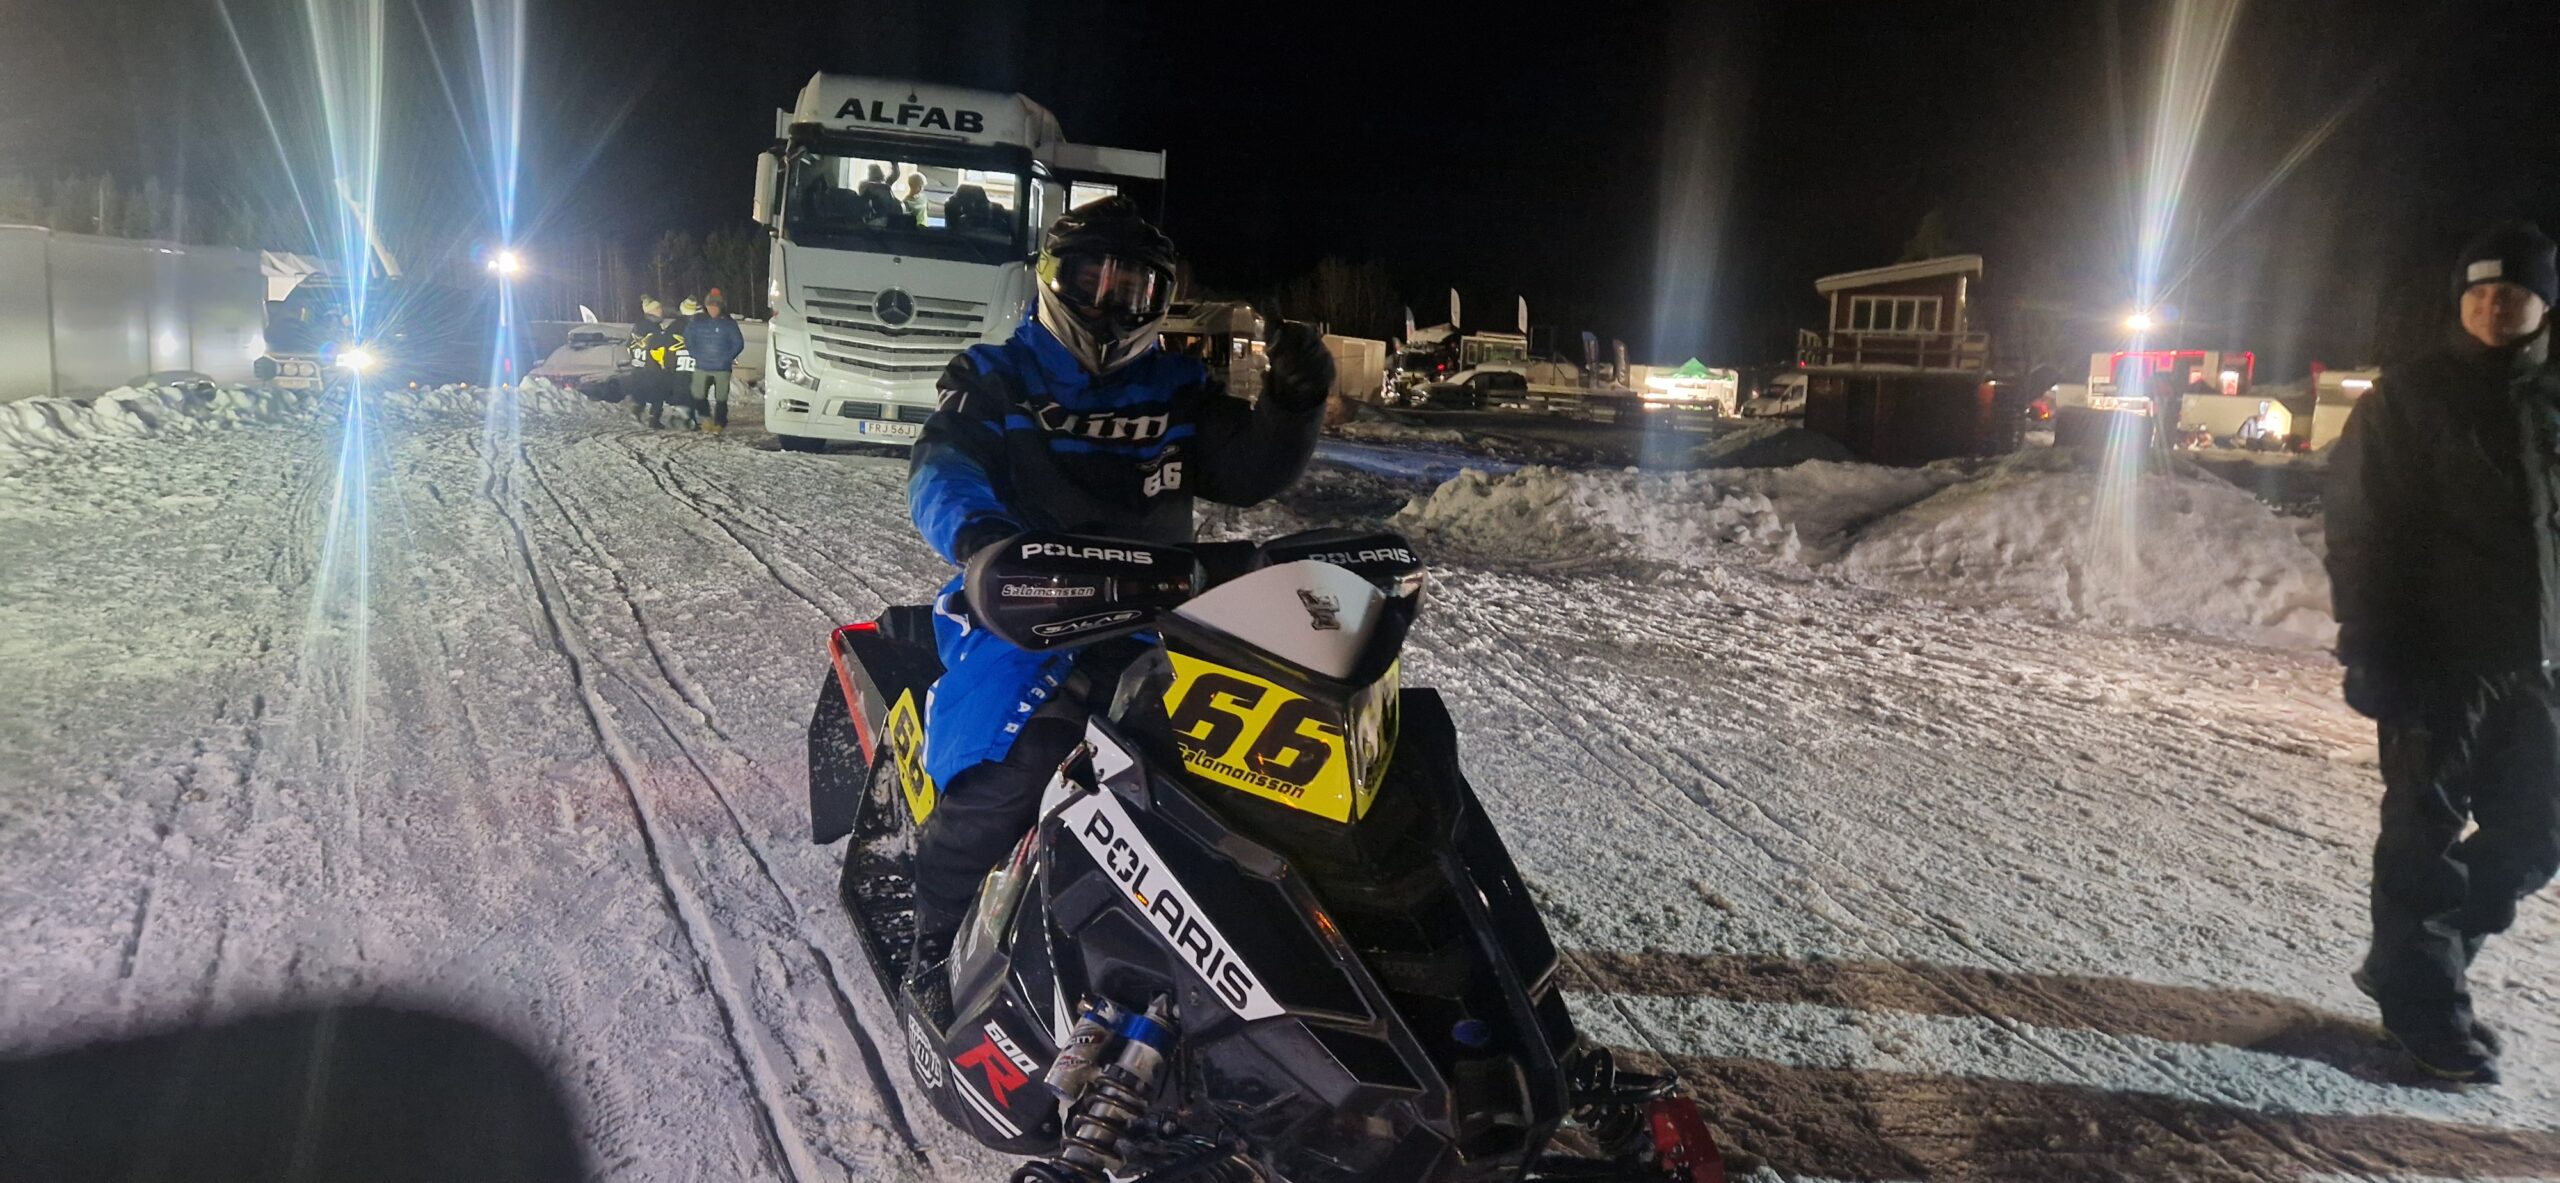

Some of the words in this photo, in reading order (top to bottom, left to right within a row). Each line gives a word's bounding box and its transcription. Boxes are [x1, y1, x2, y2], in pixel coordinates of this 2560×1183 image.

[835, 97, 984, 133] ALFAB
[1143, 461, 1183, 497] 66
[1021, 543, 1153, 565] POLARIS
[1308, 547, 1411, 565] POLARIS
[894, 705, 925, 797] 66
[1170, 673, 1343, 787] 66
[1084, 808, 1254, 1010] POLARIS
[954, 1034, 1030, 1110] R
[983, 1018, 1040, 1075] 600
